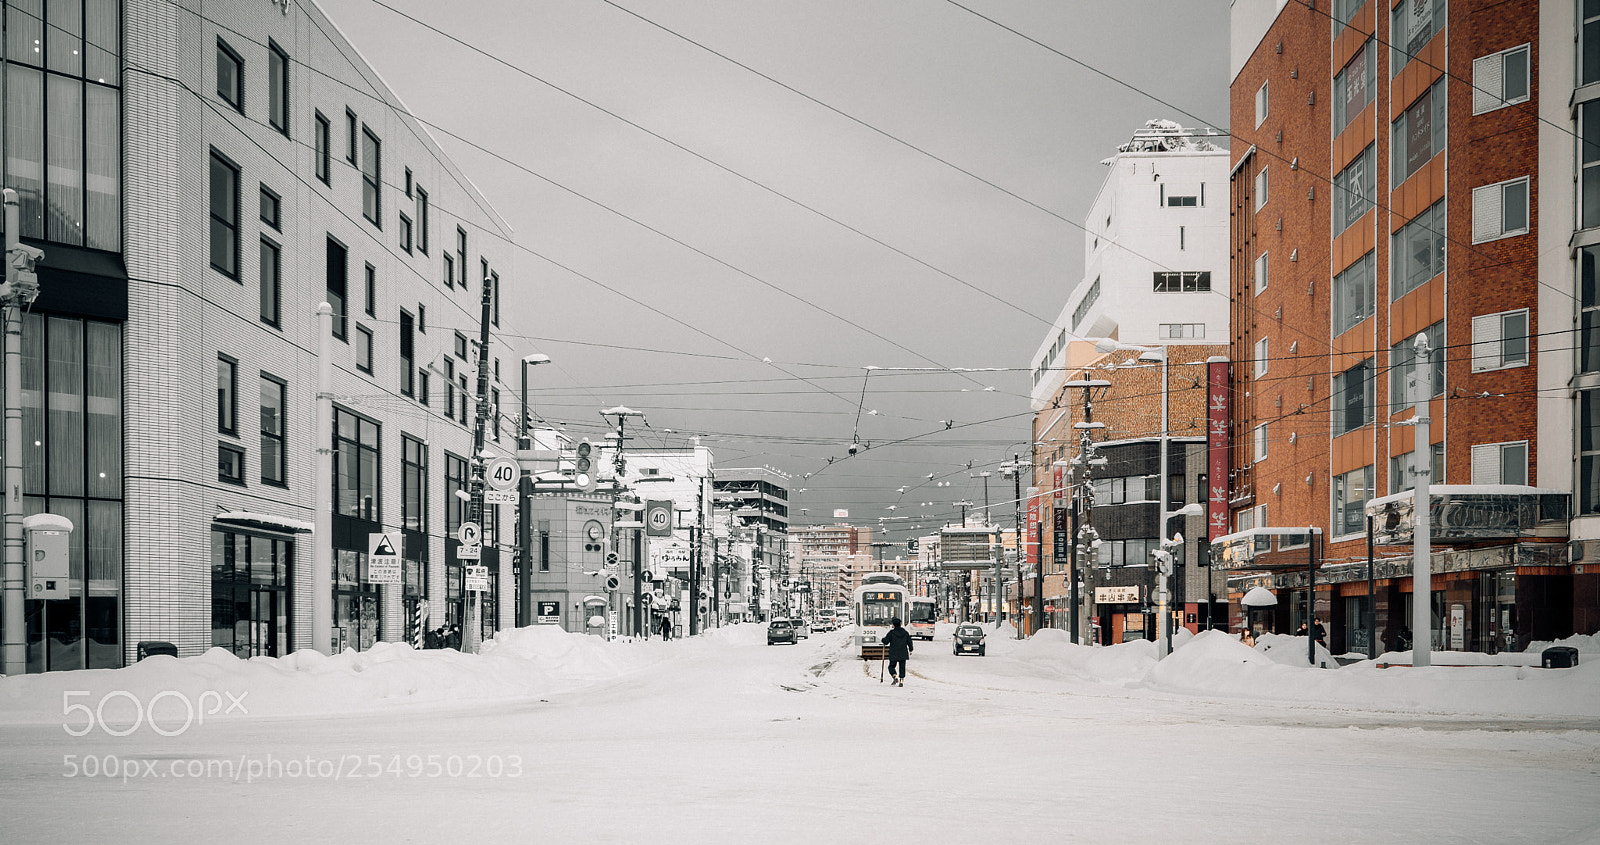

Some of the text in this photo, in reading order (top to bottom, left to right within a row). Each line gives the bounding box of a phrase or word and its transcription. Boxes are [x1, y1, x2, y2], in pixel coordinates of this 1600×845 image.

[494, 466, 513, 481] 40
[487, 493, 516, 502] ここから
[653, 513, 666, 524] 40
[544, 605, 554, 616] P
